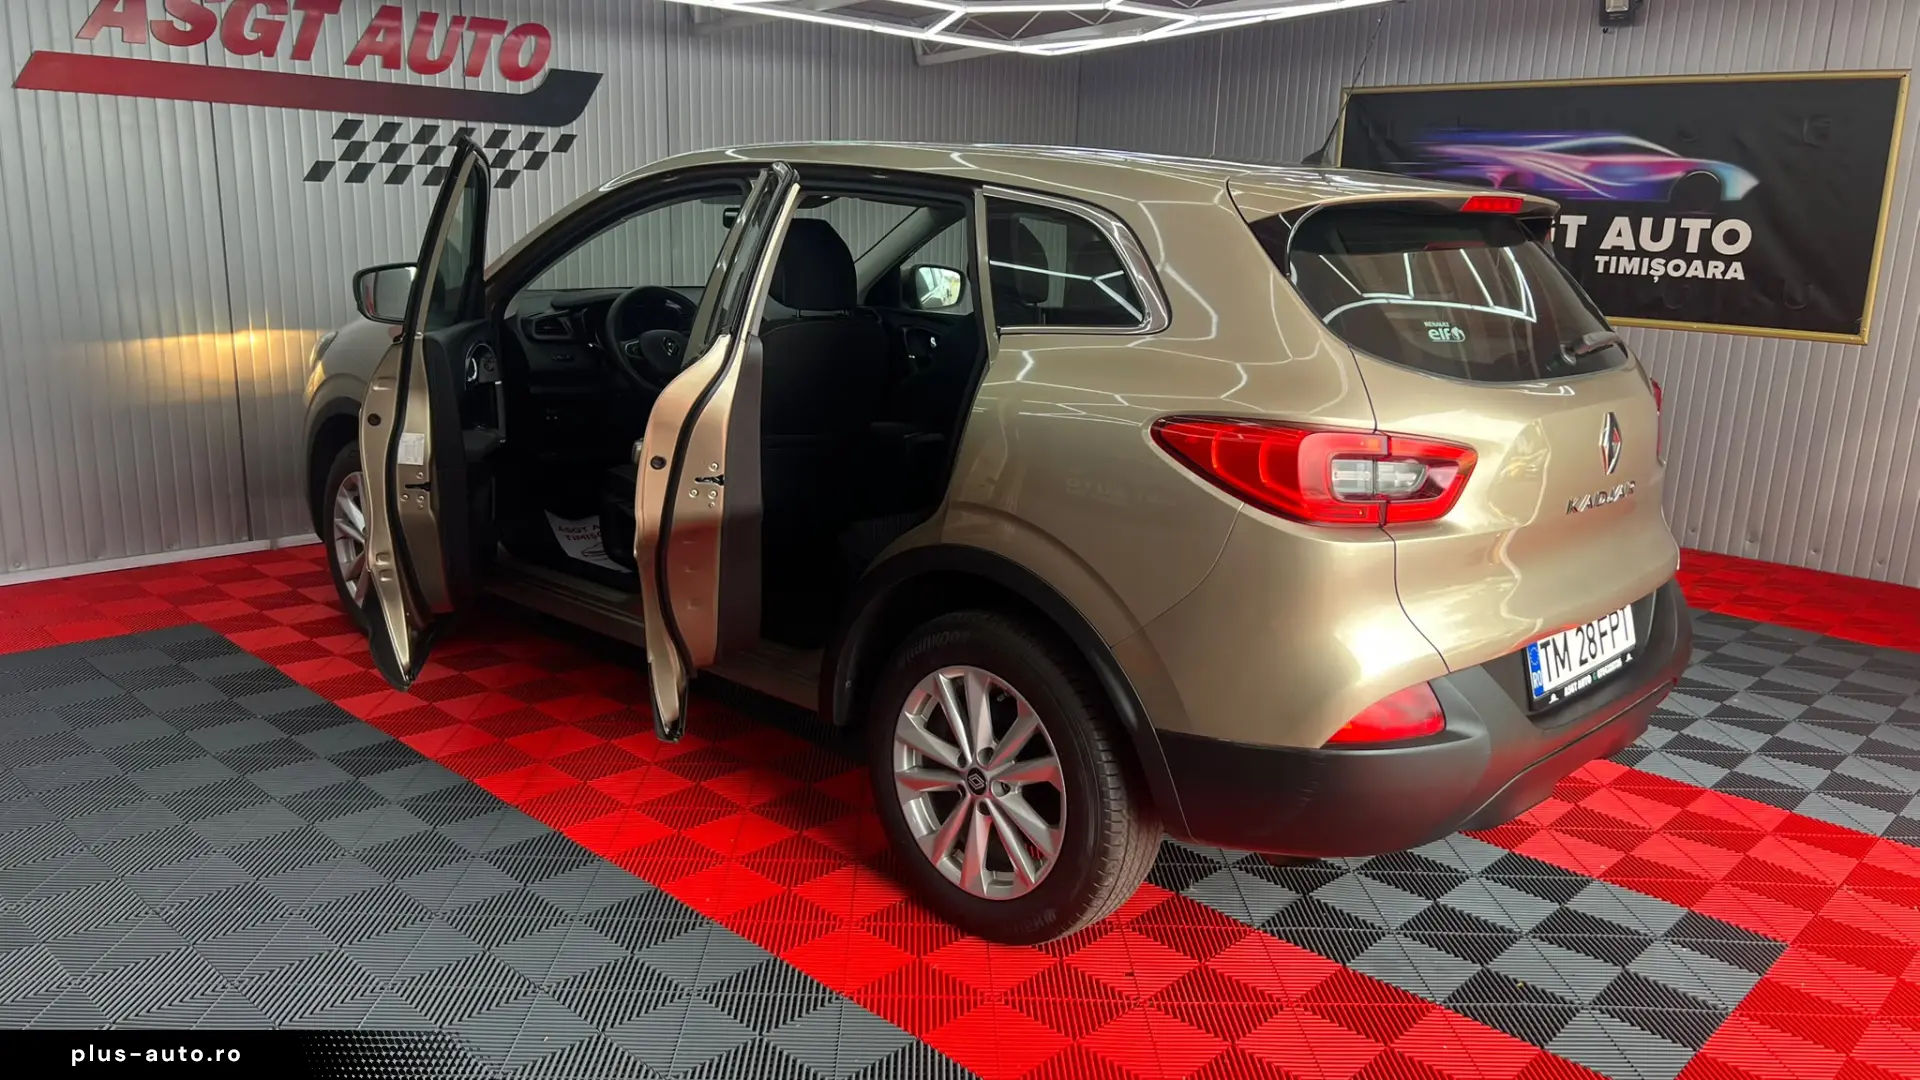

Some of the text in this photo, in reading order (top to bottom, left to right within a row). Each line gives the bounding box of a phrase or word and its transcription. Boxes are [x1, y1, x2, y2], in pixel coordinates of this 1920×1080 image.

[75, 0, 552, 82] ASGT AUTO
[1599, 216, 1752, 255] AUTO
[1595, 255, 1745, 283] TIMIȘOARA
[1428, 328, 1451, 341] elf
[1539, 631, 1572, 683] TM
